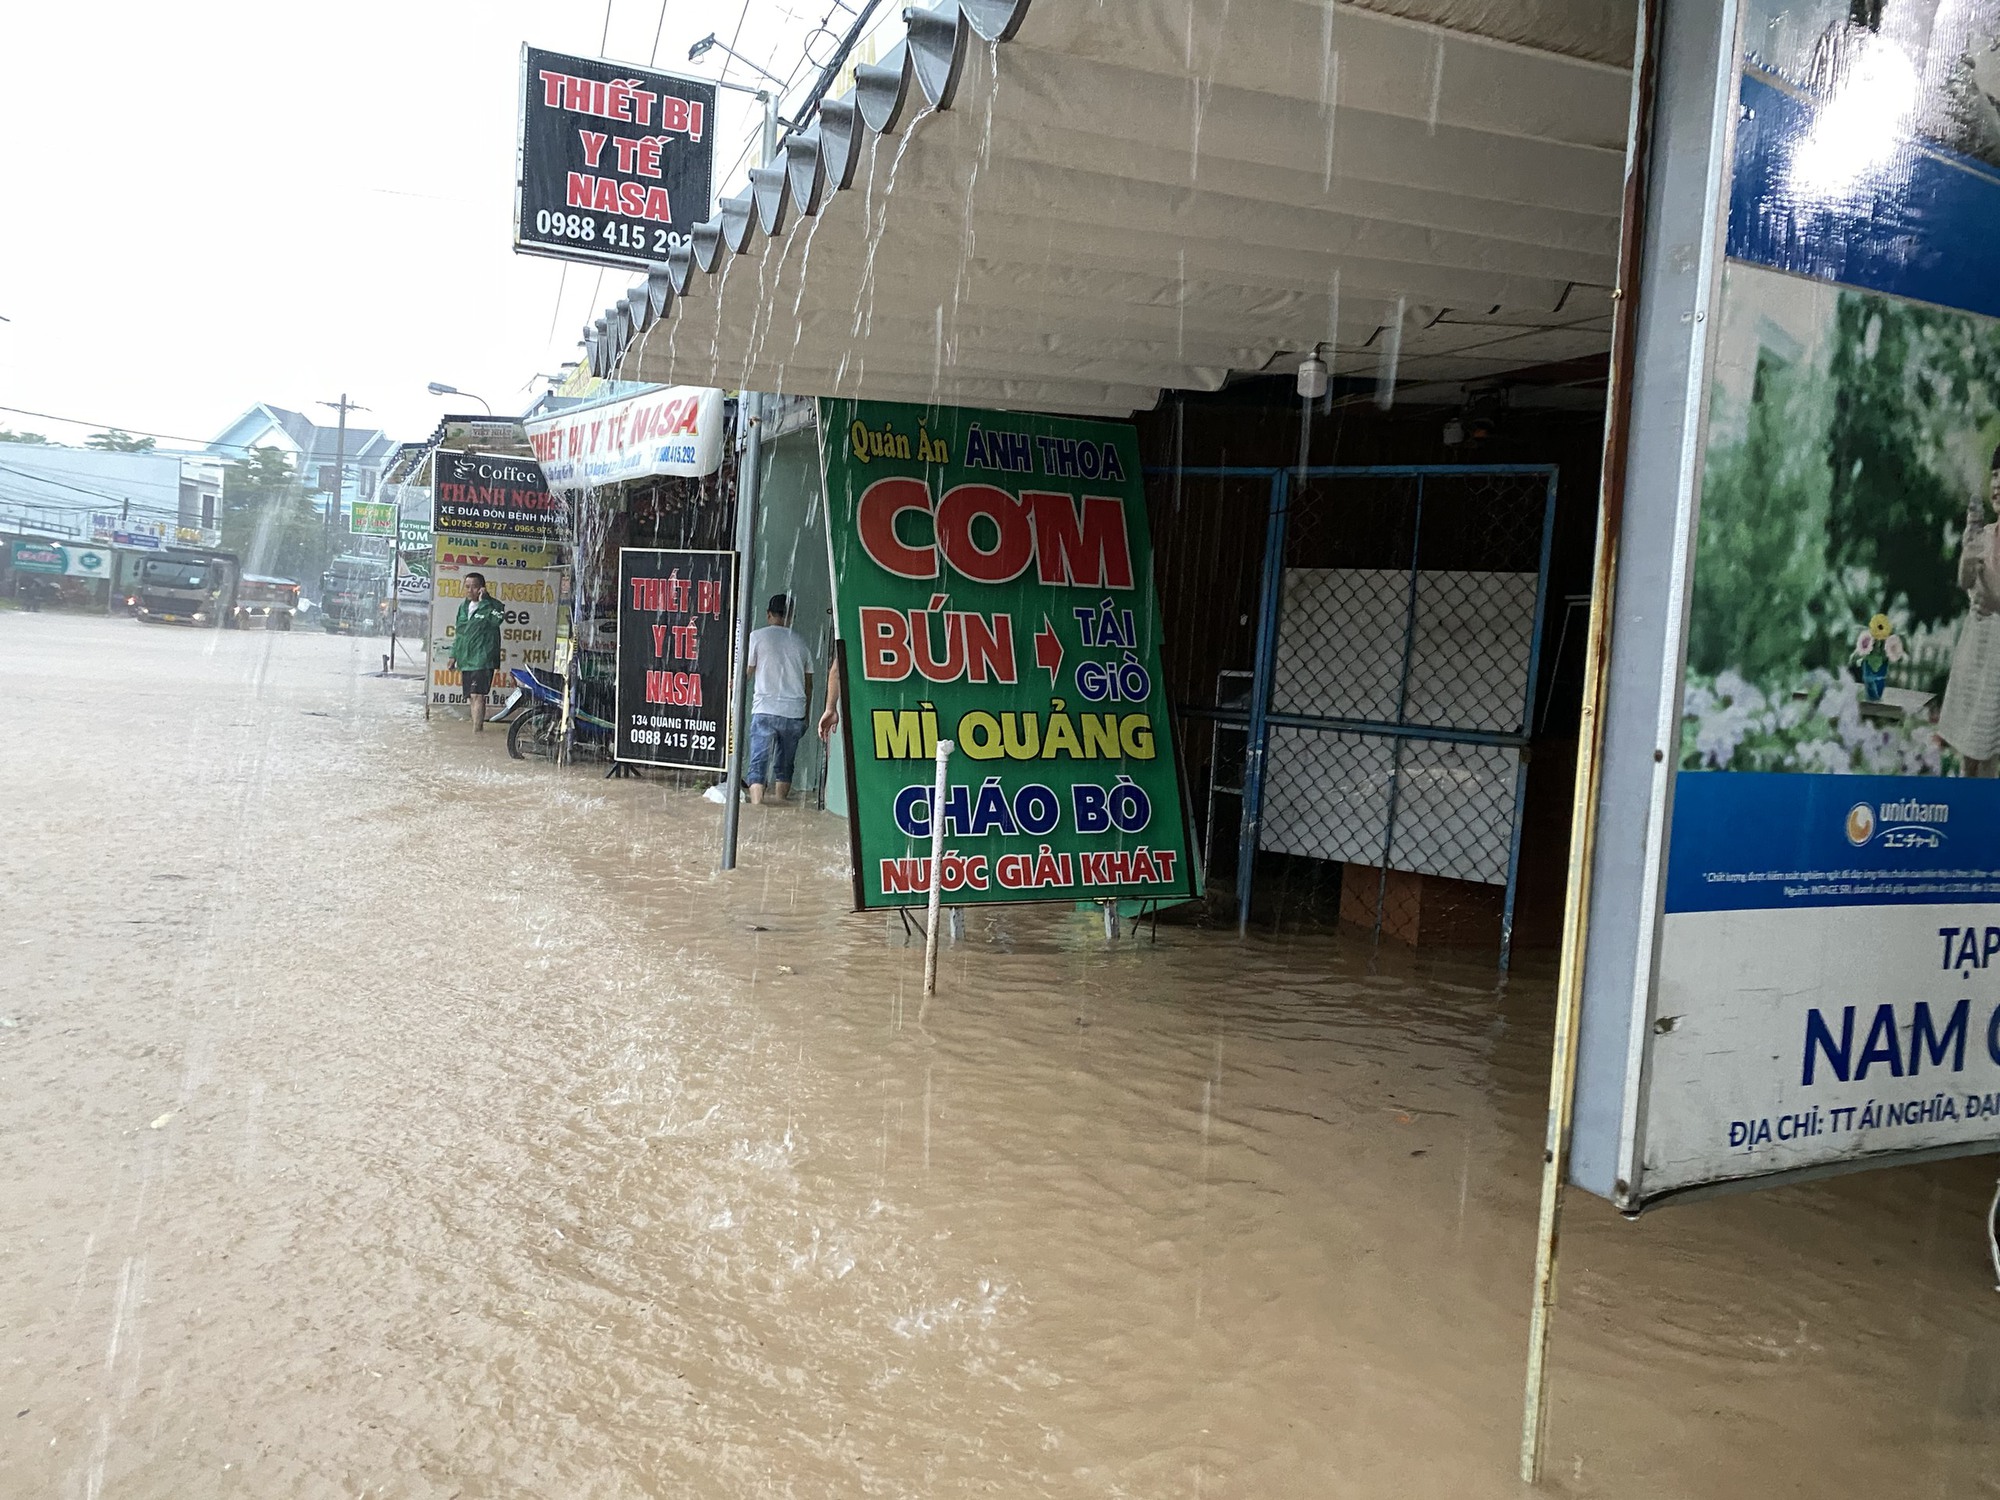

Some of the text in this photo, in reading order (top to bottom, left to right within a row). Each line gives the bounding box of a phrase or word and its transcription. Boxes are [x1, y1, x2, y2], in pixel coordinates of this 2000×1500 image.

[539, 70, 704, 142] THIẾT BỊ
[579, 129, 675, 179] Y TẾ
[566, 171, 672, 224] NASA
[536, 209, 596, 242] 0988
[602, 220, 646, 249] 415
[530, 420, 565, 464] THIẾT
[589, 418, 603, 456] Y
[607, 402, 634, 450] TẾ
[630, 395, 700, 447] NASA
[851, 417, 1126, 481] Quán Ăn ÁNH THOA
[441, 480, 506, 506] THÀNH
[479, 464, 536, 483] Coffee
[400, 530, 428, 541] TOM
[441, 506, 455, 514] XE
[458, 505, 480, 517] ĐƯA
[508, 510, 537, 522] BỆNH
[492, 522, 507, 530] 727
[857, 476, 1135, 590] CƠM
[502, 579, 554, 604] NGHĨA
[631, 568, 721, 621] THIẾT BỊ
[652, 624, 667, 658] Y
[671, 615, 698, 659] TẾ
[858, 593, 1136, 684] BÚN TÁI
[645, 669, 703, 707] NASA
[630, 729, 661, 746] 0988
[664, 732, 688, 748] 415
[691, 735, 716, 751] 292
[631, 714, 716, 732] 134 QUANG TRUNG
[871, 698, 1156, 761] MÌ QUẢNG
[893, 776, 1152, 837] CHÁO BÒ
[1880, 797, 1949, 823] unicharm
[996, 843, 1076, 890] GIẢI
[1080, 846, 1177, 886] KHÁT
[1939, 926, 2000, 979] TẠP
[1802, 999, 1971, 1086] NAM
[1728, 1118, 1772, 1151] ĐỊA
[1778, 1105, 1824, 1141] CHỈ:
[1829, 1107, 1857, 1133] TT
[1858, 1099, 1883, 1130] ÁI
[1886, 1092, 1960, 1127] NGHĨA,
